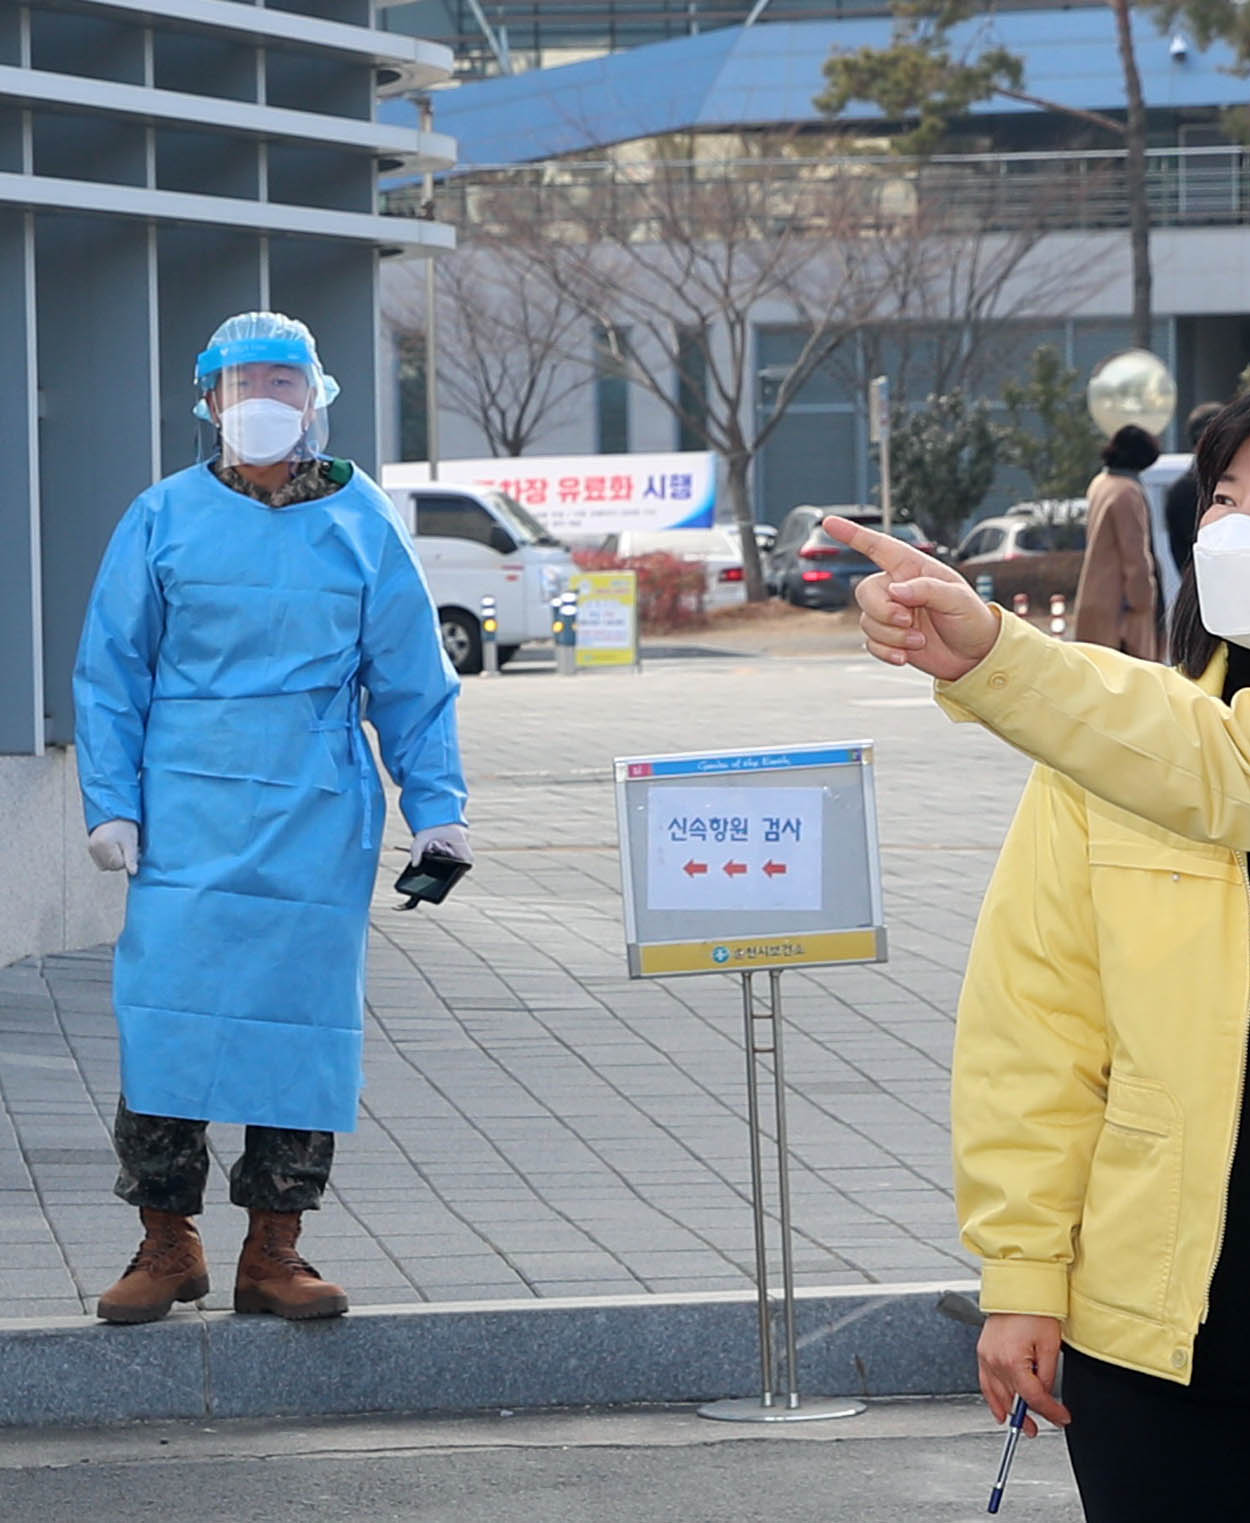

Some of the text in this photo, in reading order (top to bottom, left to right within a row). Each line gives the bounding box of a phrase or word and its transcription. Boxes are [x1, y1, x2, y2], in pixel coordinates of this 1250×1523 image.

[558, 475, 634, 504] 유료화
[643, 474, 693, 500] 시행
[667, 817, 802, 842] 신속항원 검사
